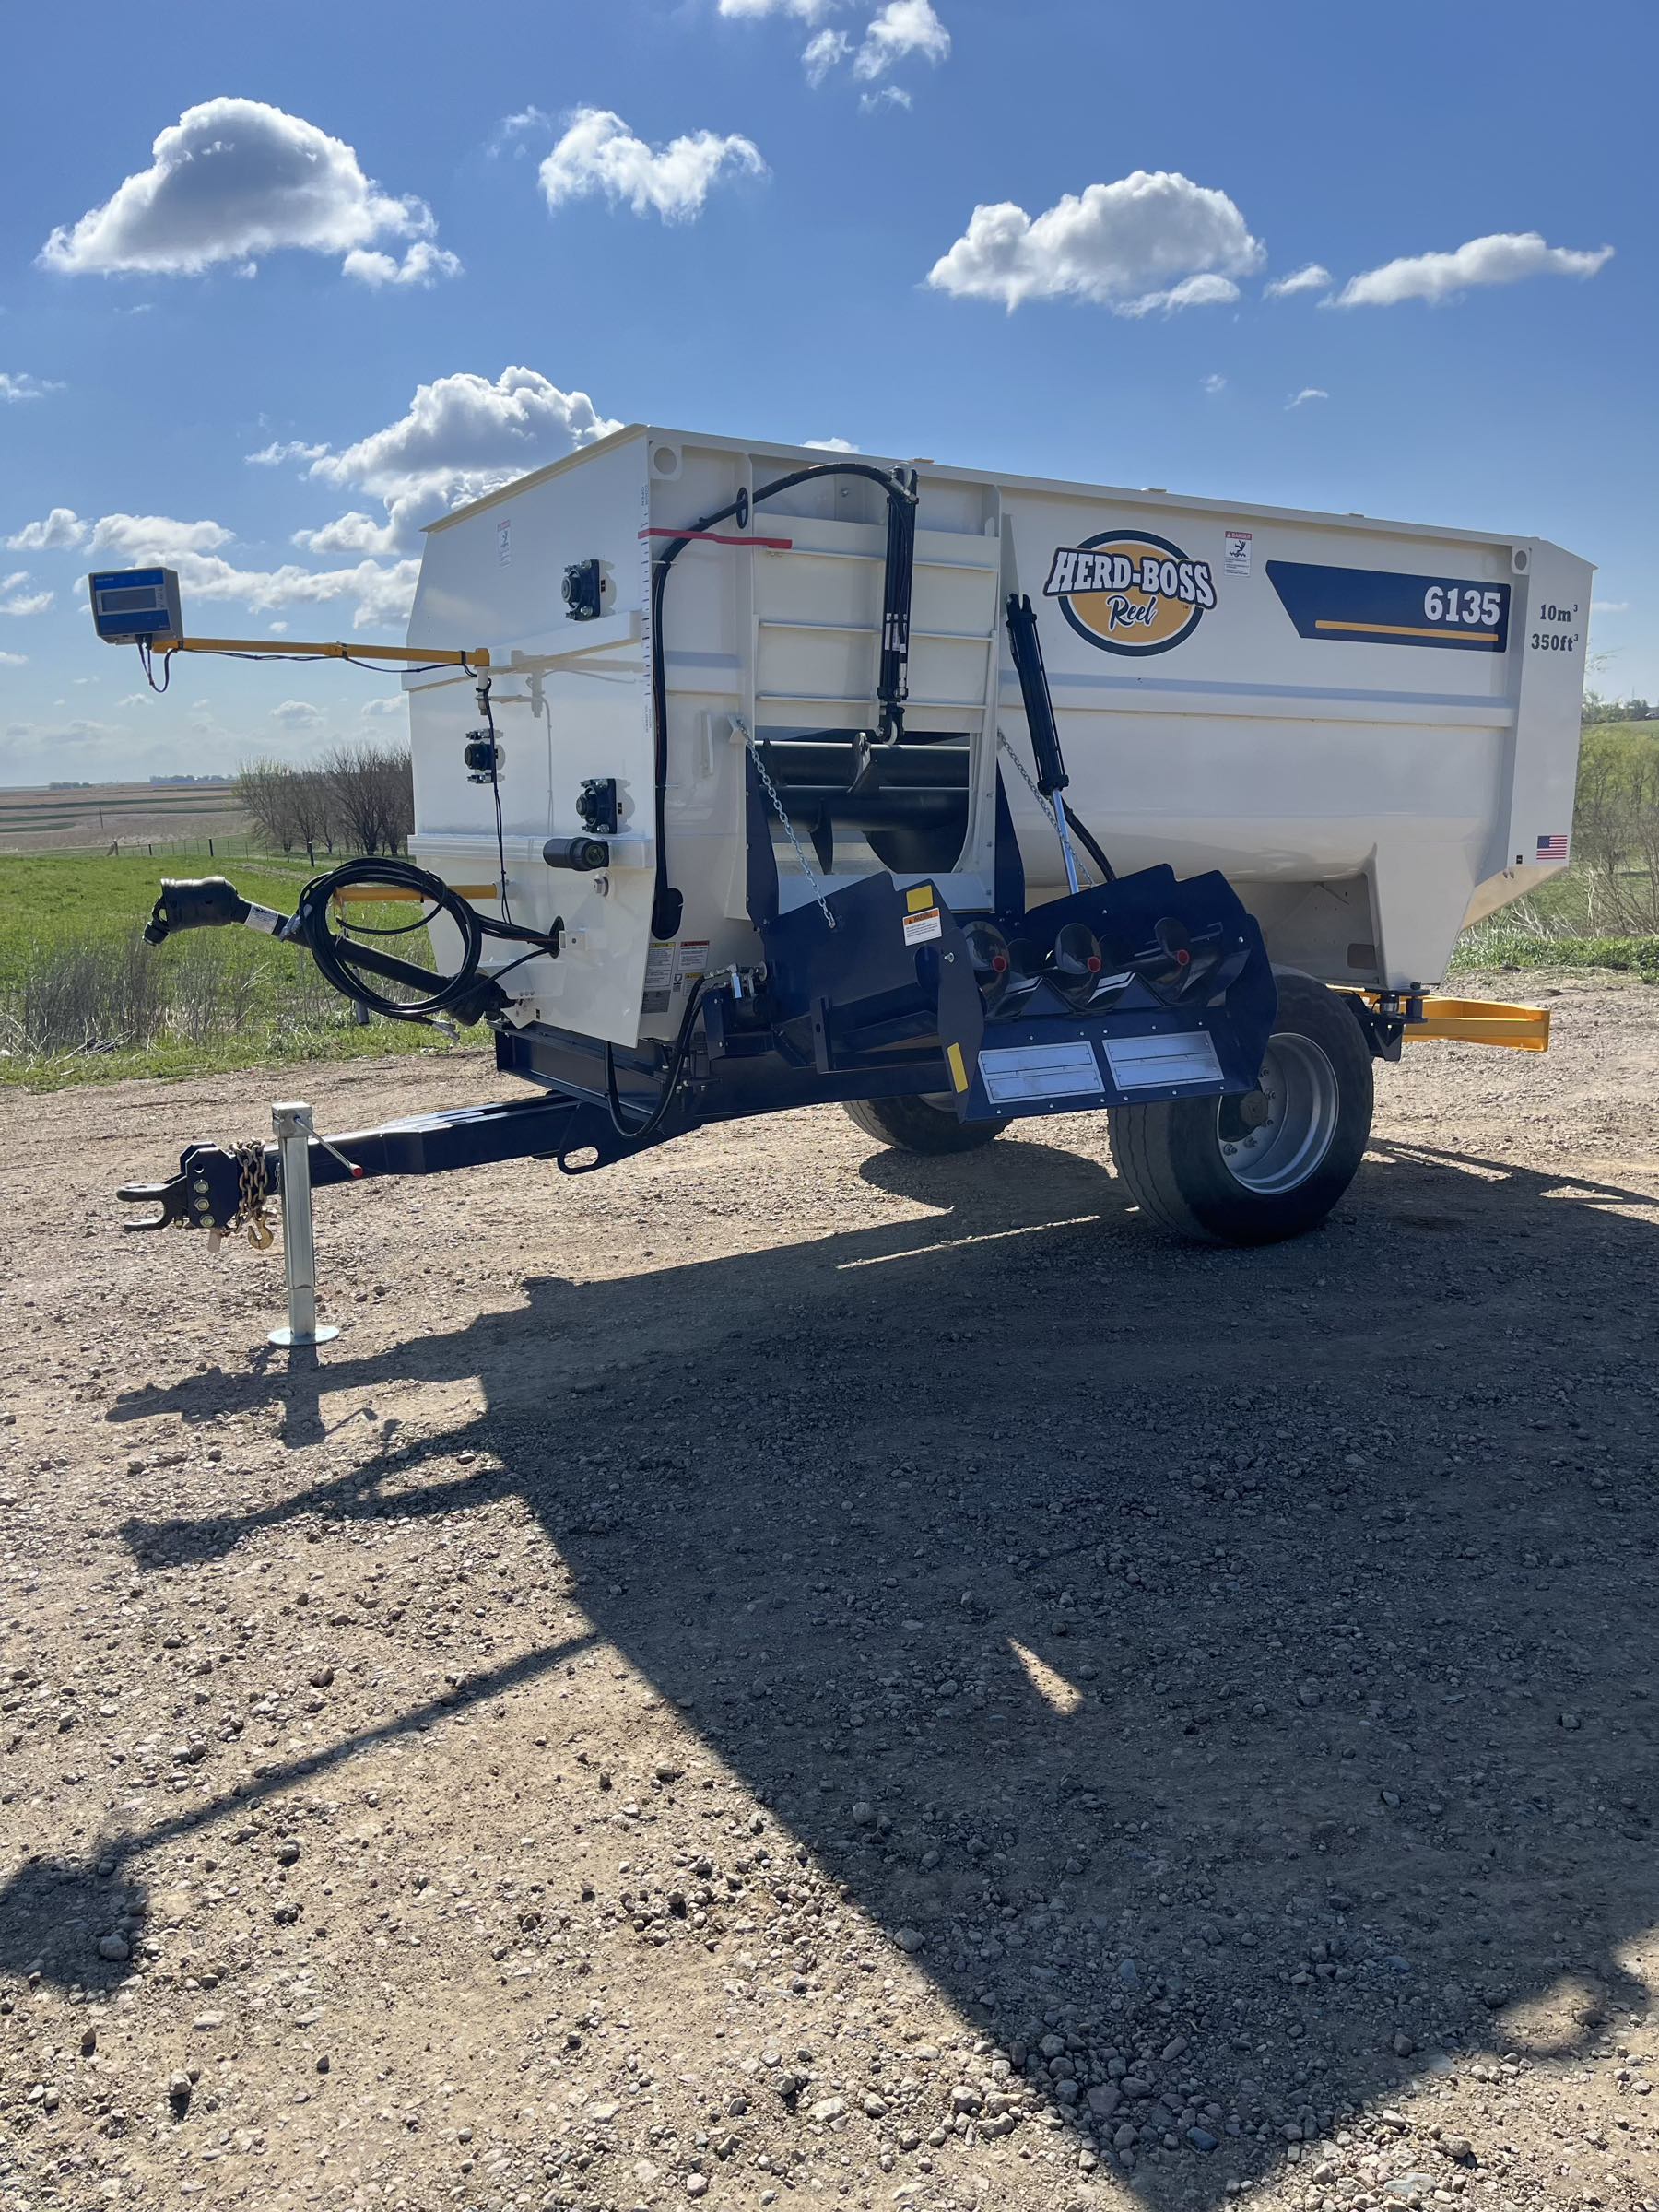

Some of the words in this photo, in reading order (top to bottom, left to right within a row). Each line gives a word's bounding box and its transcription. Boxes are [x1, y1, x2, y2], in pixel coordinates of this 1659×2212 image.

[1046, 551, 1215, 607] HERD-BOSS
[1107, 595, 1157, 630] Reel
[1424, 585, 1500, 626] 6135
